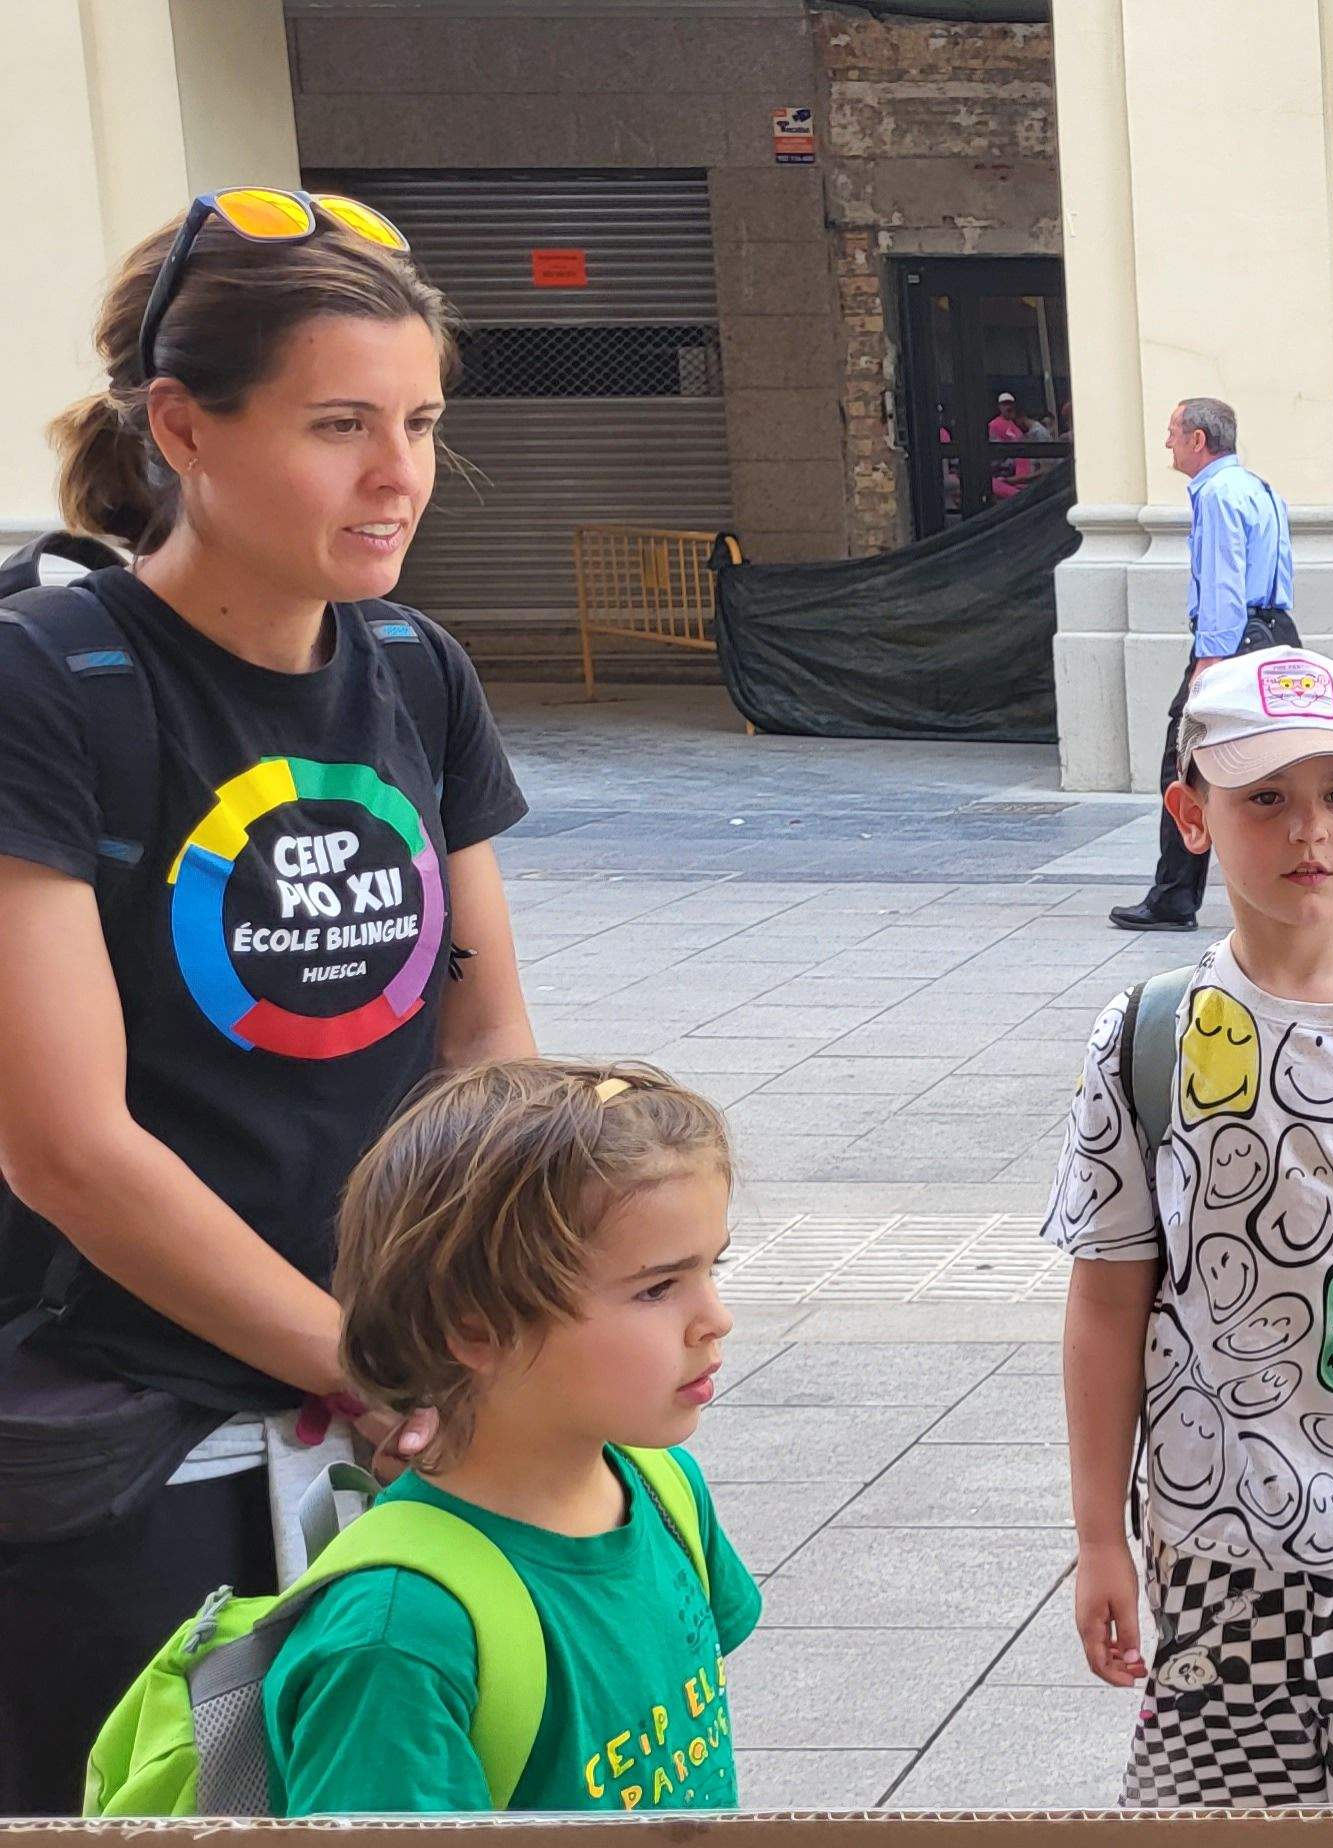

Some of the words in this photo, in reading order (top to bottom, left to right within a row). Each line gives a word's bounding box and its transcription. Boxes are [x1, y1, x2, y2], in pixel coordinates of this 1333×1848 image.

[273, 830, 359, 878] CEIP
[276, 879, 341, 919] PIO
[346, 866, 402, 914] XII
[232, 922, 320, 953] ÉCOLE
[325, 914, 419, 951] BILINGUE
[302, 960, 367, 983] HUESCA
[684, 1667, 715, 1718] EL
